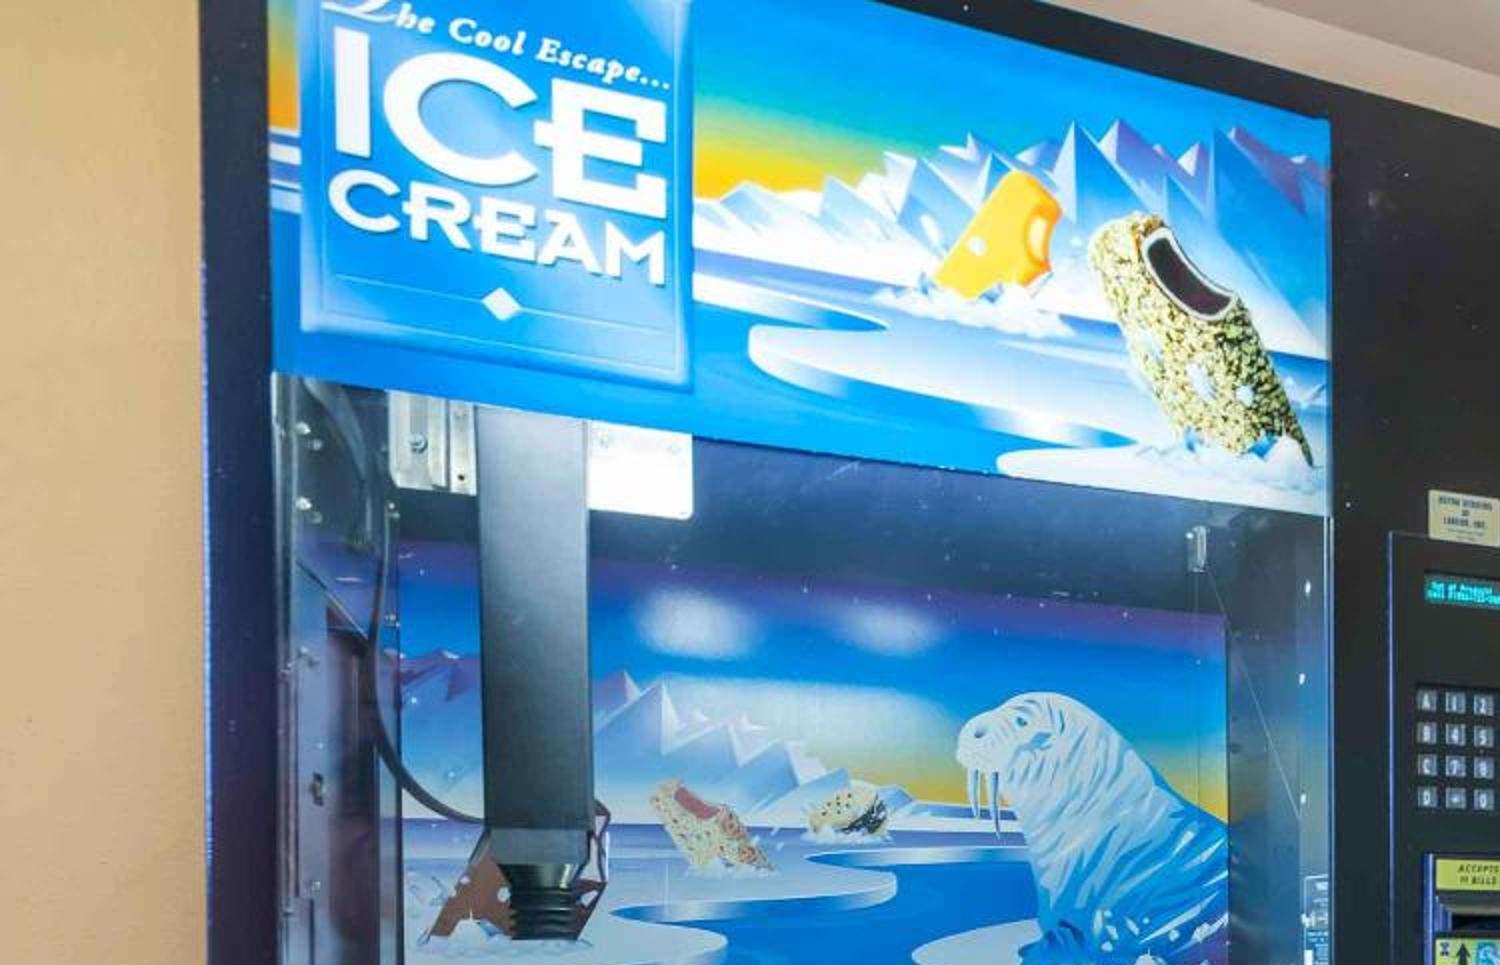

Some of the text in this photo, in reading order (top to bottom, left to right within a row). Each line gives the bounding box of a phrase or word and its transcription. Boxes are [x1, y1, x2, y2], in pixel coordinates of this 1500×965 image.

[449, 17, 525, 56] Cool
[535, 37, 671, 91] Escape...
[333, 26, 667, 219] ICE
[328, 168, 666, 287] CREAM
[1457, 864, 1500, 874] ACCEPTS
